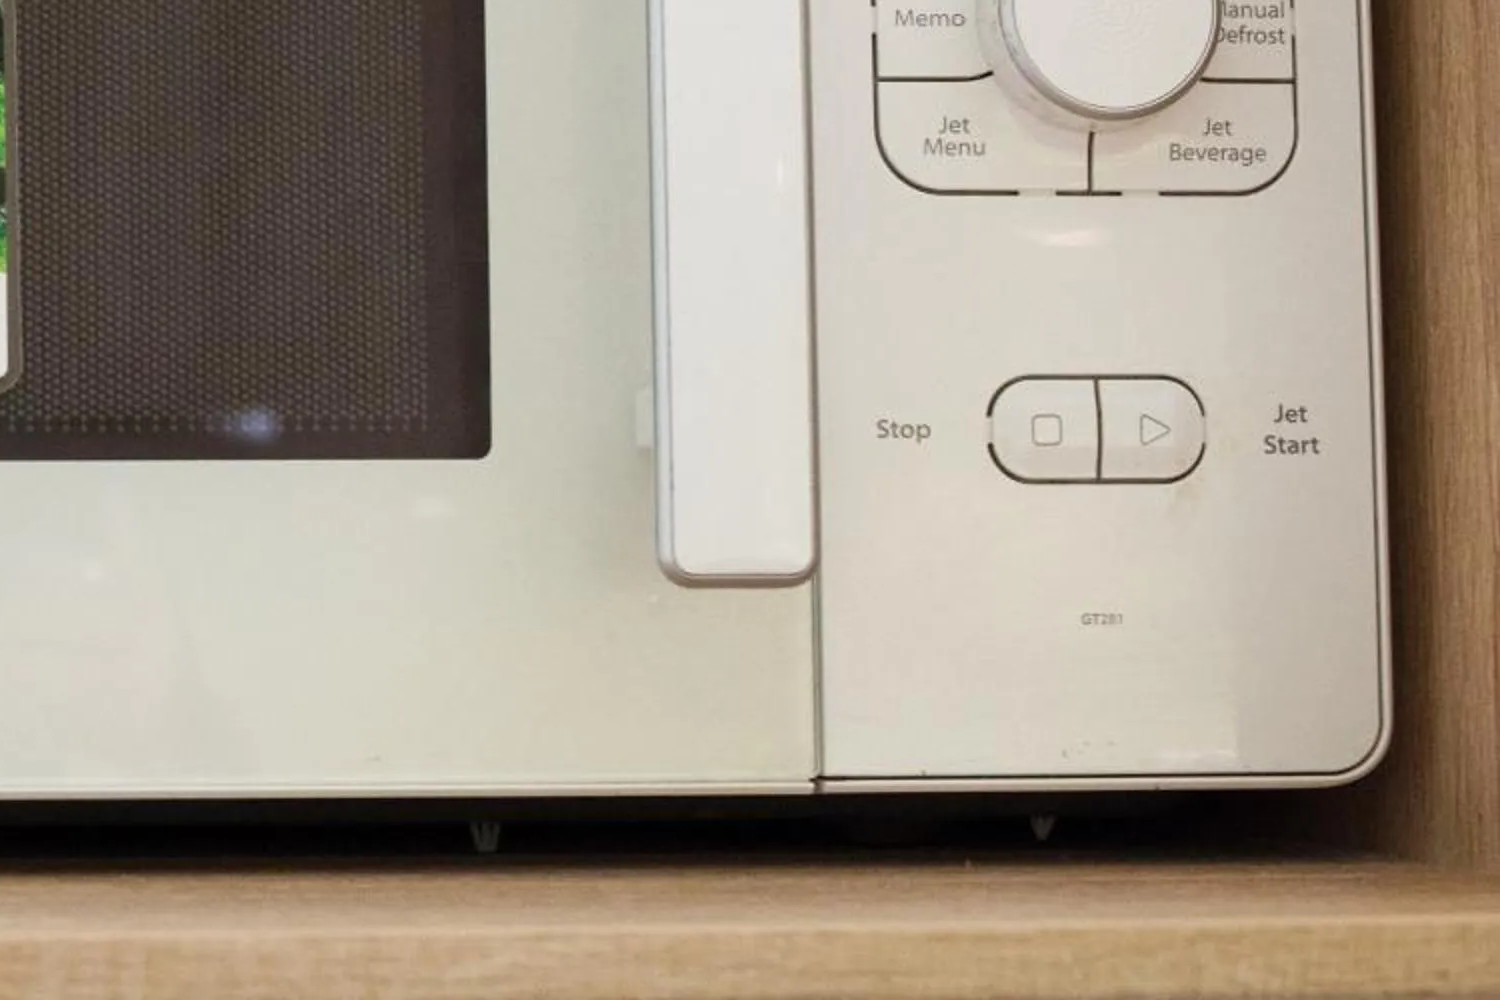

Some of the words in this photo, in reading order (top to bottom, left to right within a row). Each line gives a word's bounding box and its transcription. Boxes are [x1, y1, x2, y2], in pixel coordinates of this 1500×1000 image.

[894, 9, 966, 28] Memo
[1220, 0, 1285, 18] anual
[938, 116, 970, 135] Jet
[1202, 119, 1233, 137] Jet
[923, 138, 987, 157] Menu
[1169, 143, 1267, 167] Beverage
[1273, 403, 1308, 424] Jet
[876, 419, 932, 444] Stop
[1263, 434, 1321, 456] Start
